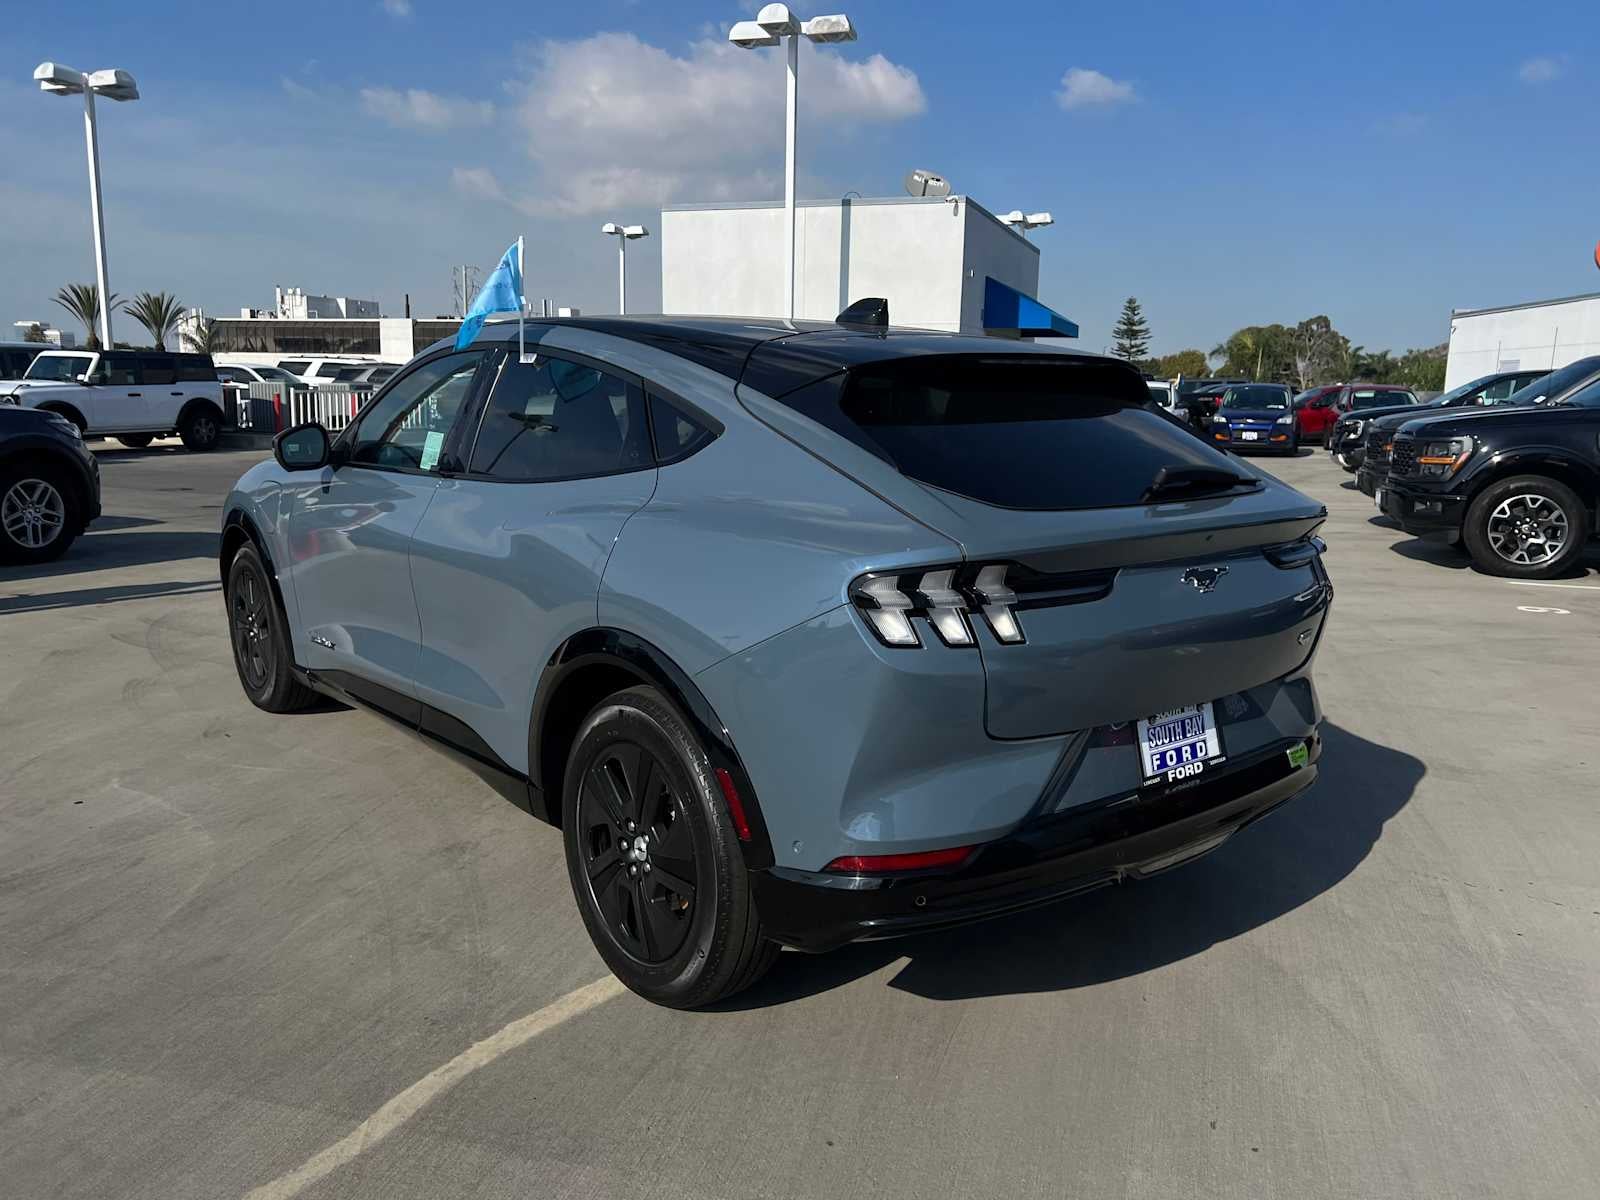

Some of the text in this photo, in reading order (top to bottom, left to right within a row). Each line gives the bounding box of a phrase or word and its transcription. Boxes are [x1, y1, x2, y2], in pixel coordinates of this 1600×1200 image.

[1149, 715, 1204, 748] SOUTH BAY
[1151, 741, 1207, 771] FORD
[1167, 761, 1204, 782] FORD
